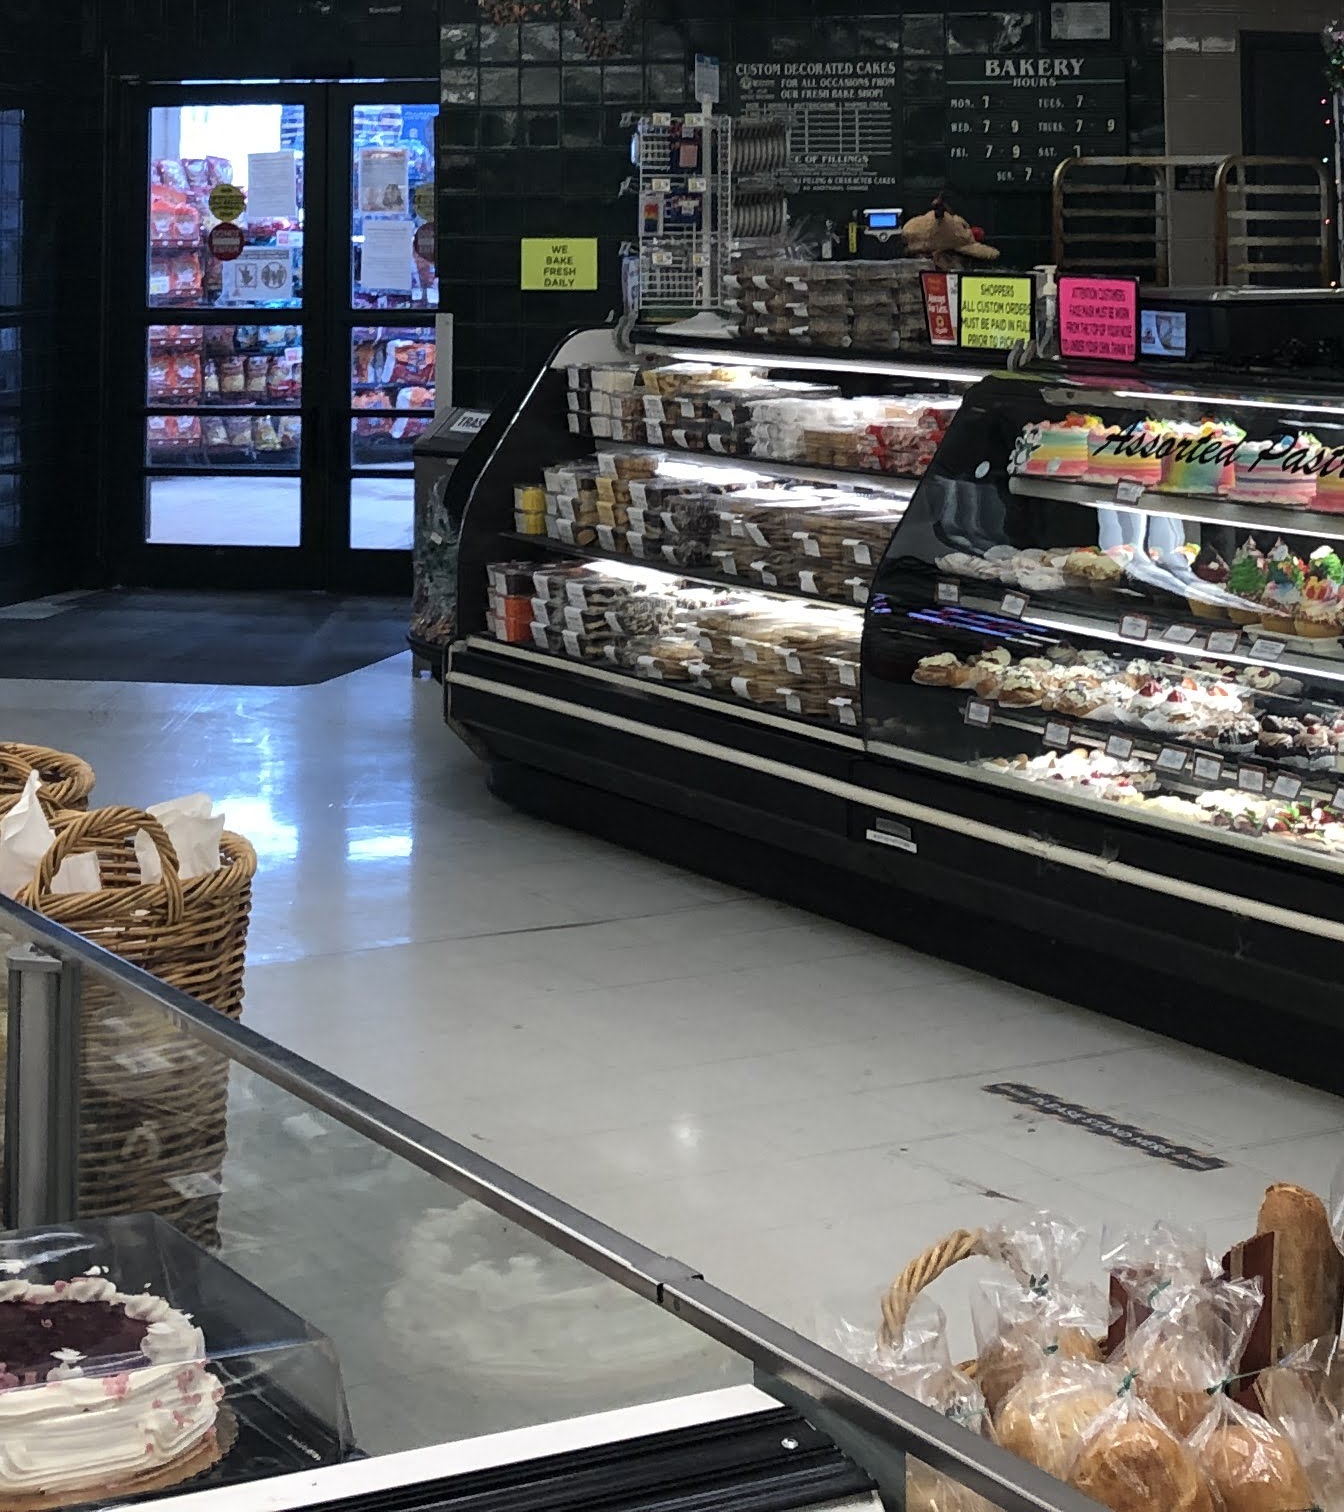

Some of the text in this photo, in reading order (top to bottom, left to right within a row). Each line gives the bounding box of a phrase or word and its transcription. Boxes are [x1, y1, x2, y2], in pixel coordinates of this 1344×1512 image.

[736, 61, 896, 76] CUSTOM DECORATED CAKES
[985, 58, 1085, 76] BAKERY
[780, 77, 895, 88] FOR ALL OCCASIONS FROM
[1012, 77, 1057, 88] HOURS
[780, 89, 798, 99] OUR
[1107, 119, 1115, 133] 9
[552, 245, 568, 254] WE
[546, 256, 573, 265] BAKE
[544, 267, 576, 276] FRESH
[544, 278, 574, 287] DAILY
[980, 283, 1015, 298] SHOPPERS
[961, 300, 977, 313] ALL
[978, 301, 1004, 315] CUSTOM
[980, 319, 990, 330] BE
[991, 319, 1006, 332] PAID
[1007, 320, 1015, 331] IN
[968, 334, 988, 346] PRIOR
[457, 417, 487, 428] TRAS
[1093, 424, 1247, 467] Assorted
